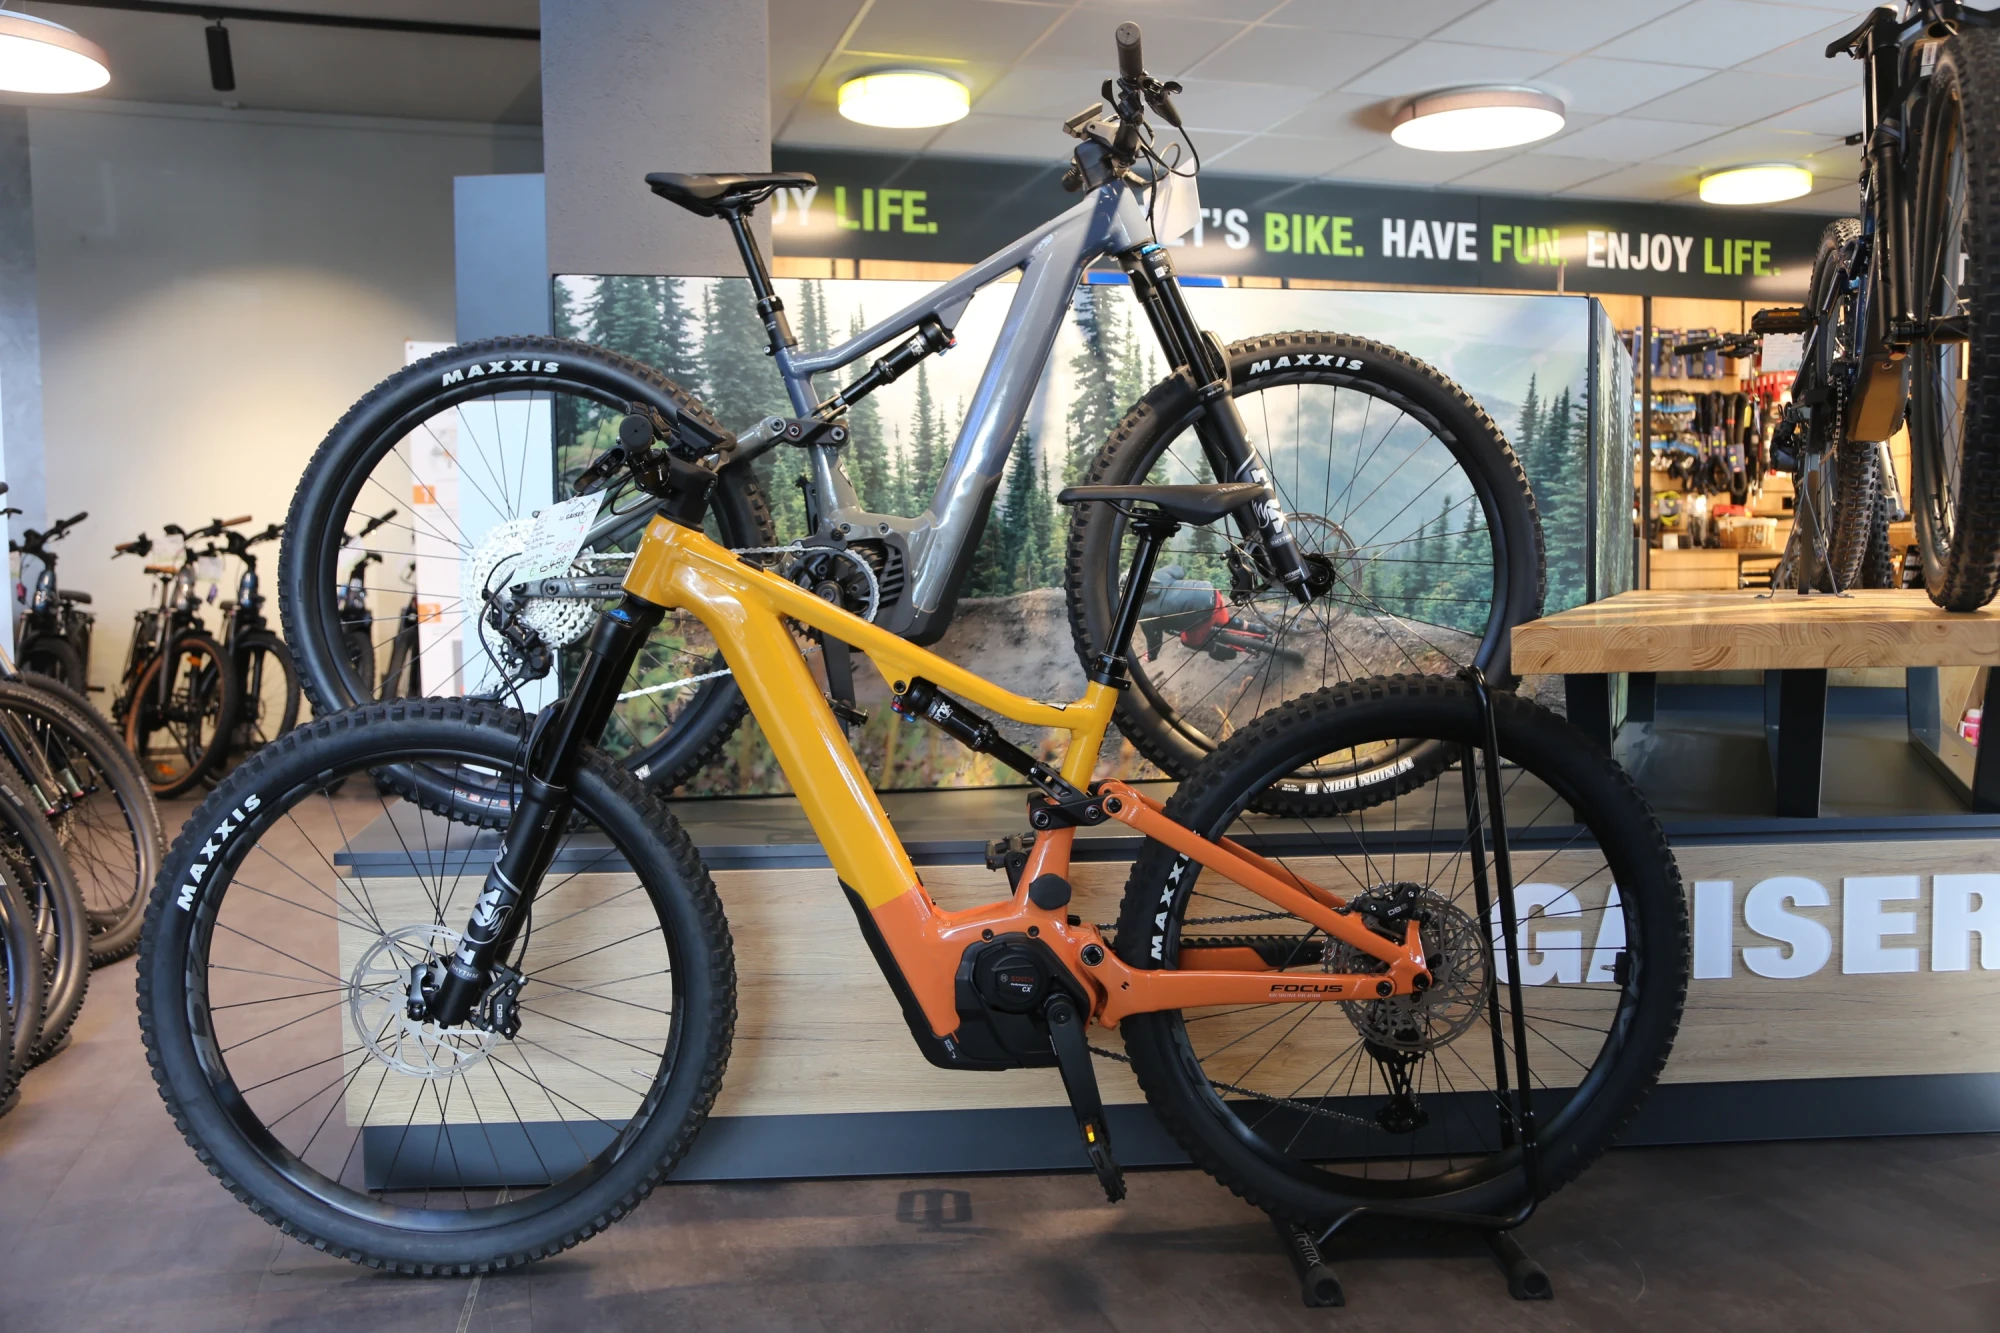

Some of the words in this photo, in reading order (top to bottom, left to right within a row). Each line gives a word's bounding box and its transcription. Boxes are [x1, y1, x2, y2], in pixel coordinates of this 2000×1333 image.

[834, 186, 938, 235] LIFE.
[1139, 205, 1250, 250] T'S
[1265, 212, 1364, 258] BIKE.
[1382, 218, 1478, 262] HAVE
[1492, 224, 1567, 267] FUN.
[1586, 230, 1693, 273] ENJOY
[1704, 238, 1780, 277] LIFE.
[442, 359, 560, 387] MAXXIS
[1249, 354, 1364, 375] MAXXIS
[932, 701, 954, 723] FOX
[177, 794, 261, 911] MAXXIS
[1150, 830, 1200, 961] MAXX
[1010, 975, 1034, 983] BOSCH
[1270, 984, 1343, 993] FOCUS
